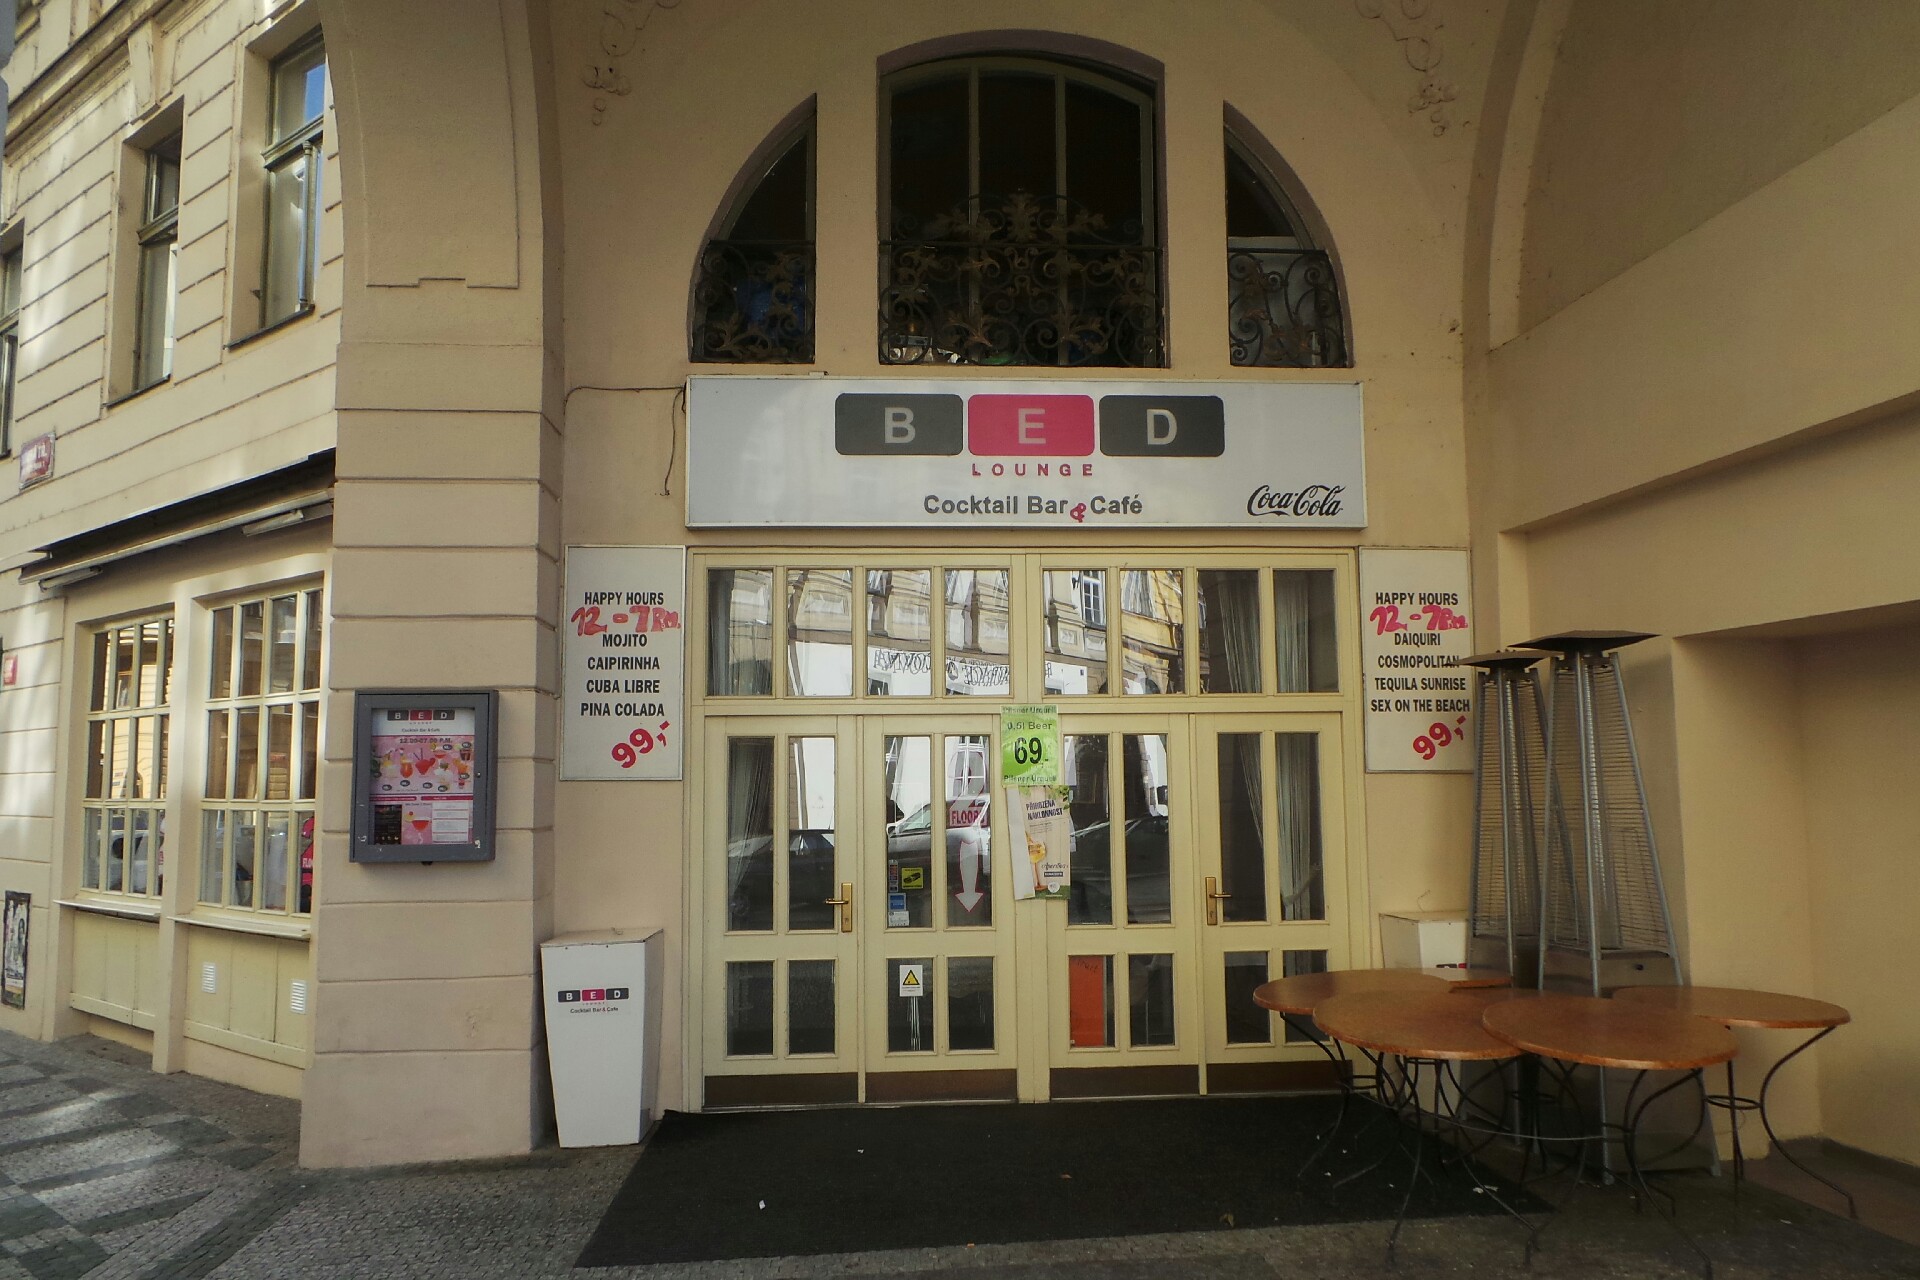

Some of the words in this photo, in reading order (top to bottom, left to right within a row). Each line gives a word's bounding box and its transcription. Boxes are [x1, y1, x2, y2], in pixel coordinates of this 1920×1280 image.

[972, 463, 1092, 477] LOUNGE
[923, 495, 1018, 514] Cocktail
[1027, 496, 1068, 514] Bar
[1090, 494, 1143, 514] Café
[584, 592, 622, 605] HAPPY
[626, 592, 664, 605] HOURS
[1376, 592, 1415, 605] HAPPY
[1419, 592, 1459, 605] HOURS
[602, 634, 648, 648] MOJITO
[1394, 632, 1441, 648] DAIQUIRI
[587, 656, 660, 670] CAIPIRINHA
[1377, 655, 1460, 668] COSMOPOLITAN
[586, 679, 620, 693] CUBA
[624, 679, 660, 693] LIBRE
[1374, 677, 1418, 692] TEQUILA
[1420, 677, 1466, 691] SUNRISE
[580, 702, 611, 717] PINA
[614, 702, 665, 717] COLADA
[1370, 699, 1392, 712] SEX
[1394, 699, 1410, 712] ON
[1412, 699, 1433, 712] THE
[1435, 699, 1470, 712] BEACH
[1028, 722, 1053, 730] Beer
